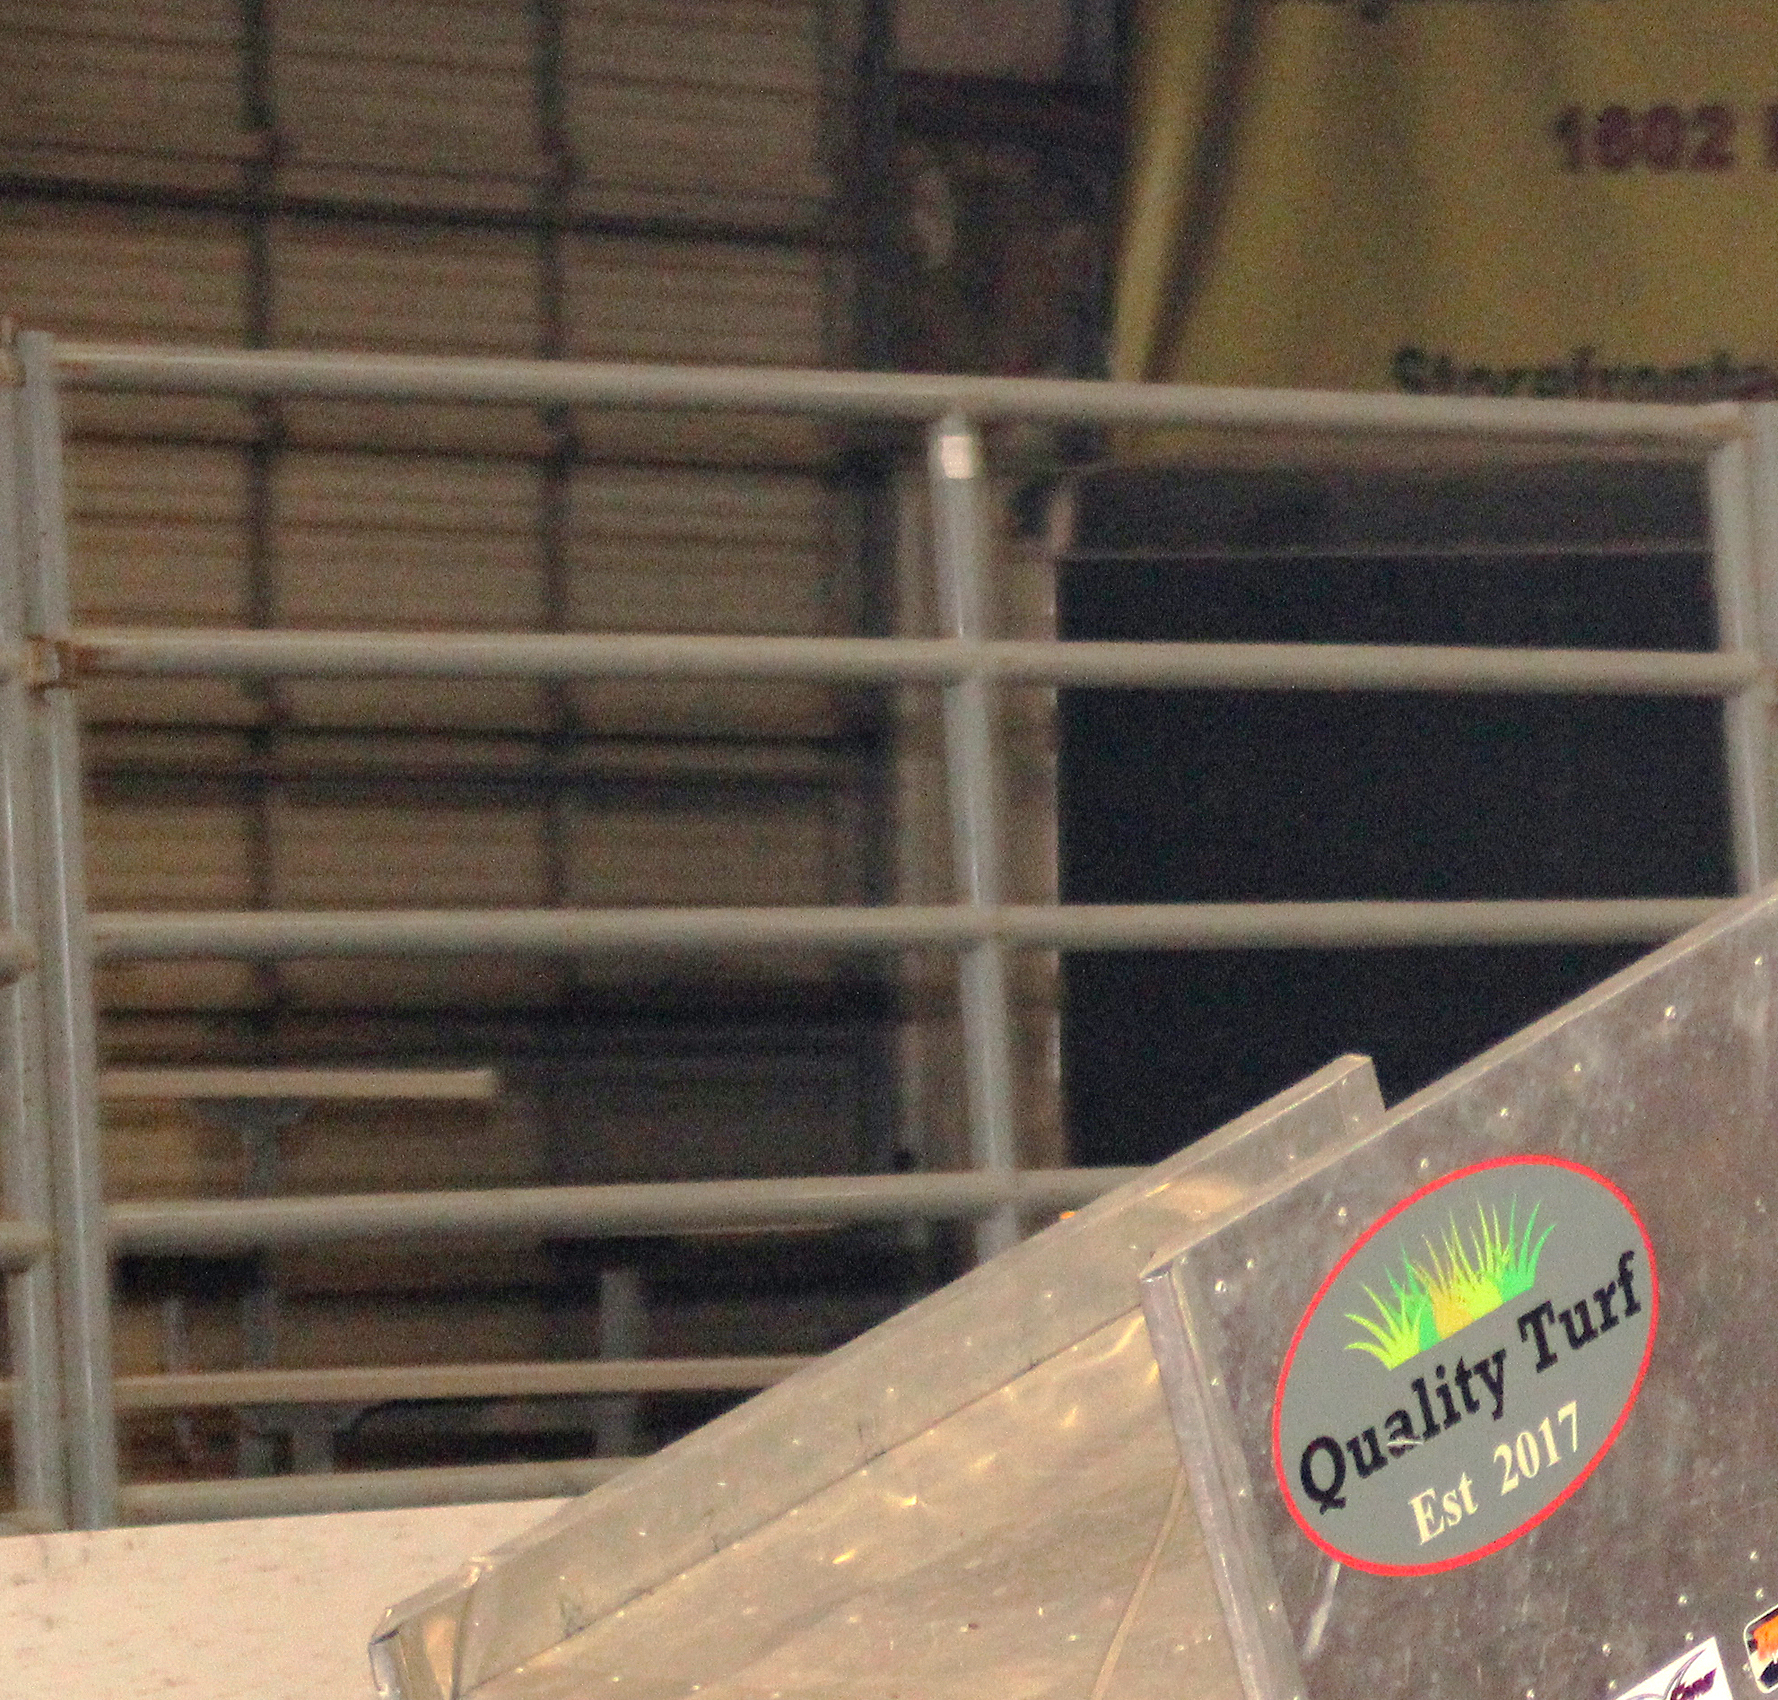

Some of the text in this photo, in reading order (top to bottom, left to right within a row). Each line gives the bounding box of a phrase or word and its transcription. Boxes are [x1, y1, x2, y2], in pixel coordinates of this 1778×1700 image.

[1299, 1251, 1644, 1516] Quality Turf
[1406, 1399, 1582, 1546] Est 2017
